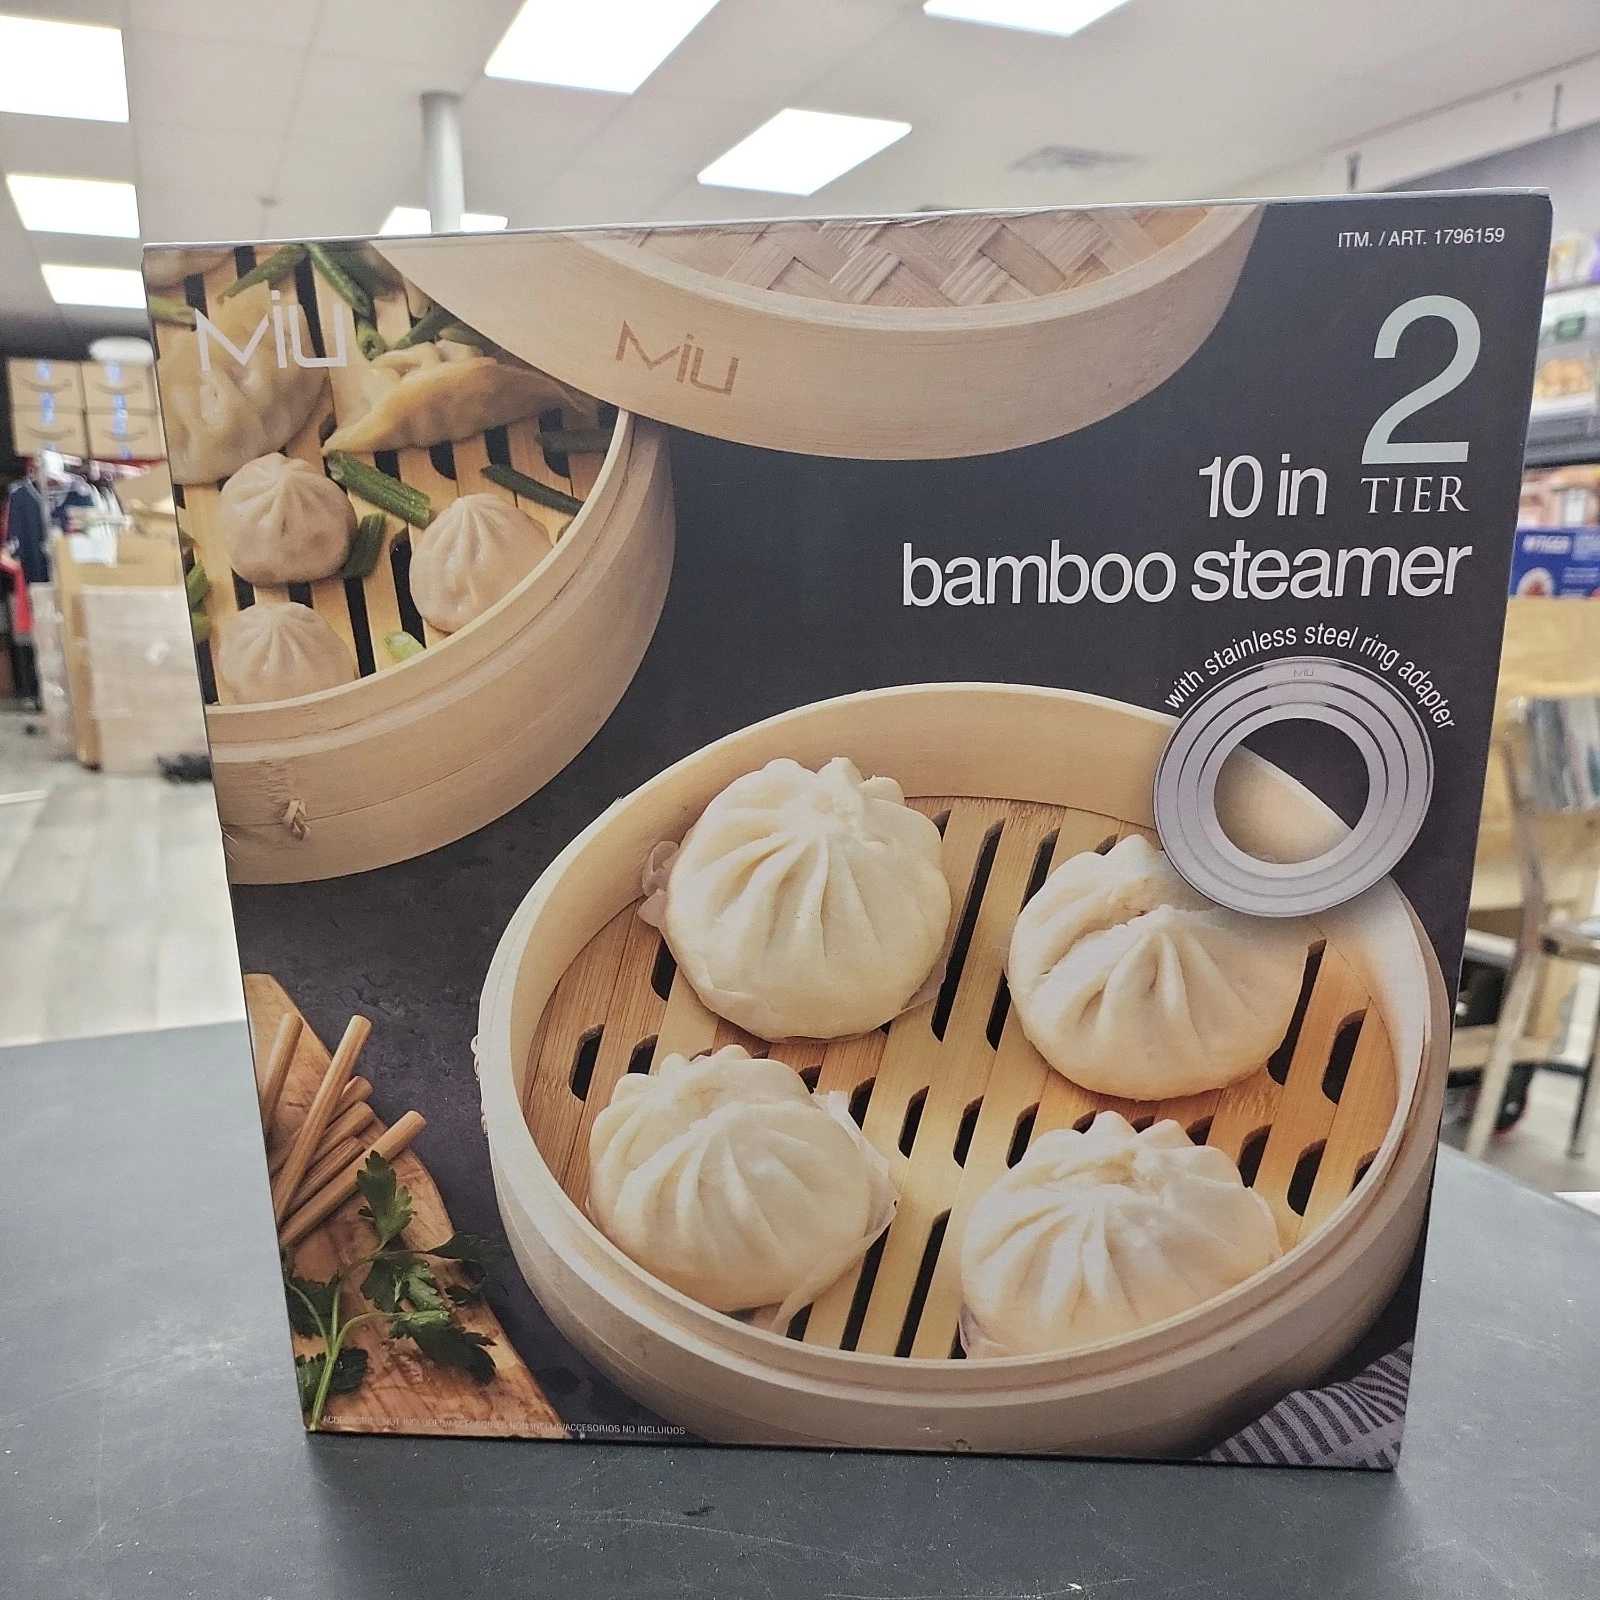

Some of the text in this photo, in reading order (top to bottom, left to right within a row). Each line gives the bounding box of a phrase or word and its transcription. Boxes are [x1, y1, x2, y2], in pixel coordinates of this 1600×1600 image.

[1338, 232, 1373, 247] ITM.
[1388, 229, 1427, 246] ART.
[1434, 228, 1505, 245] 1796159
[1361, 295, 1481, 464] 2
[1199, 453, 1327, 518] 10 in
[1361, 475, 1470, 514] TIER
[903, 539, 1473, 607] bamboo steamer
[1164, 622, 1456, 730] with stainless steel ring adapter
[622, 1424, 635, 1434] NO
[638, 1424, 686, 1436] INCLUIDOS
